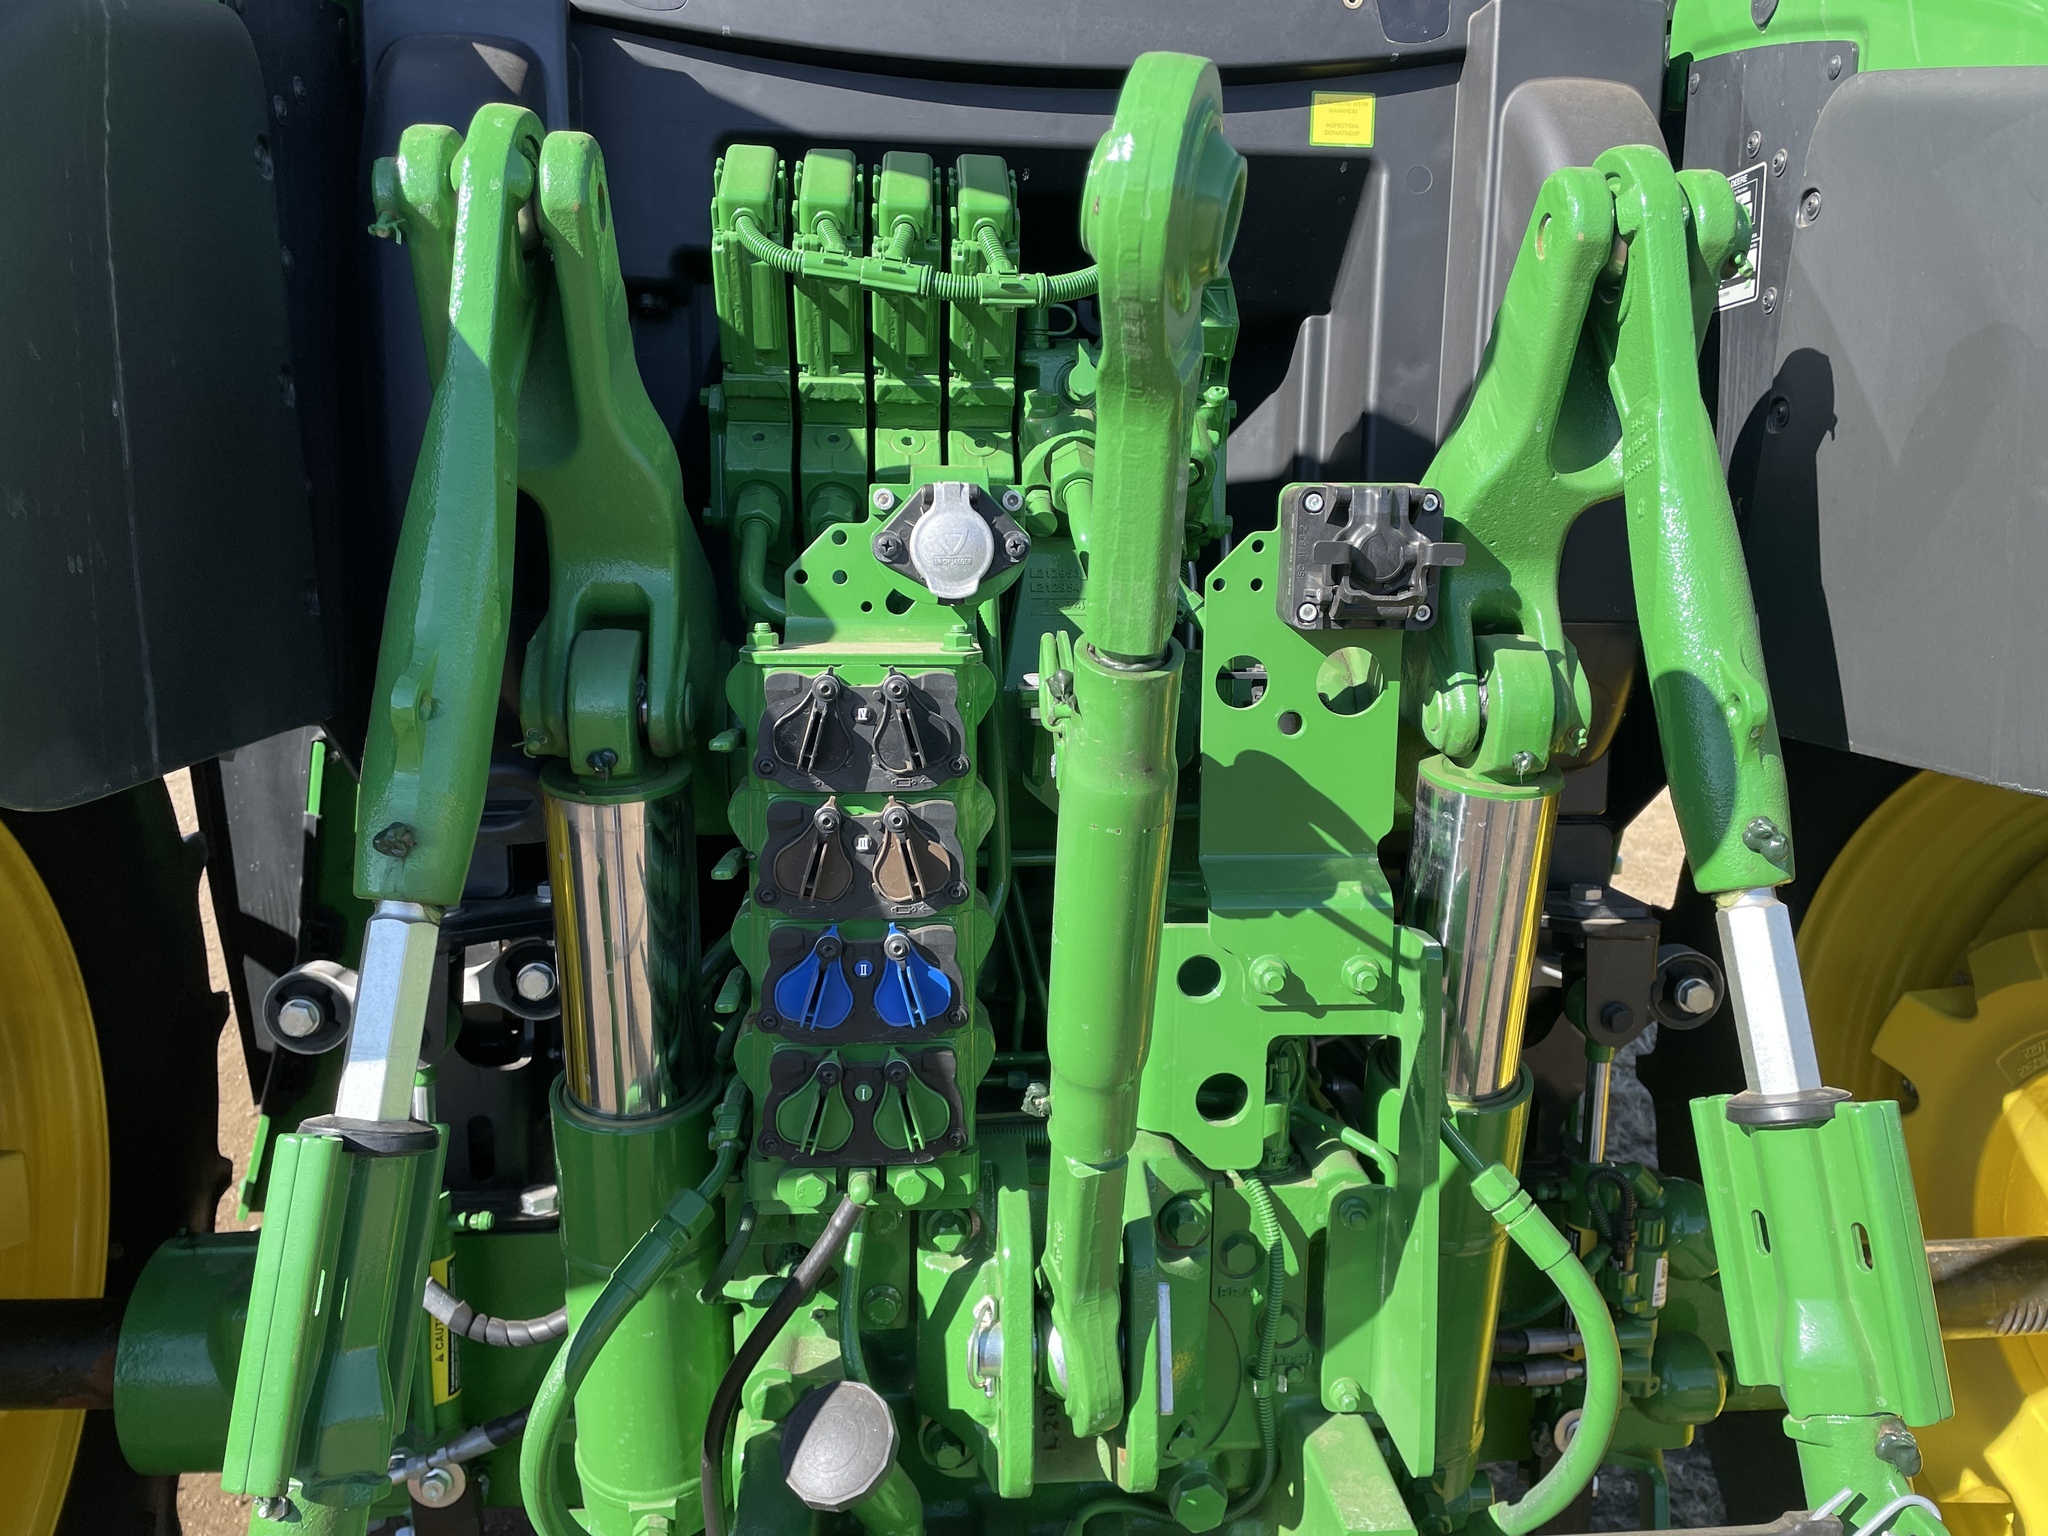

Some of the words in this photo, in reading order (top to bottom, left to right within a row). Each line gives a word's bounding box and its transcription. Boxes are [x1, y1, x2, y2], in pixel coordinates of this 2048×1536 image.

[1730, 174, 1748, 188] DEERE
[1297, 564, 1306, 579] ISO
[857, 707, 868, 720] IV
[857, 837, 869, 850] III
[860, 964, 868, 977] II
[861, 1089, 867, 1100] I
[435, 1320, 445, 1351] CAUT
